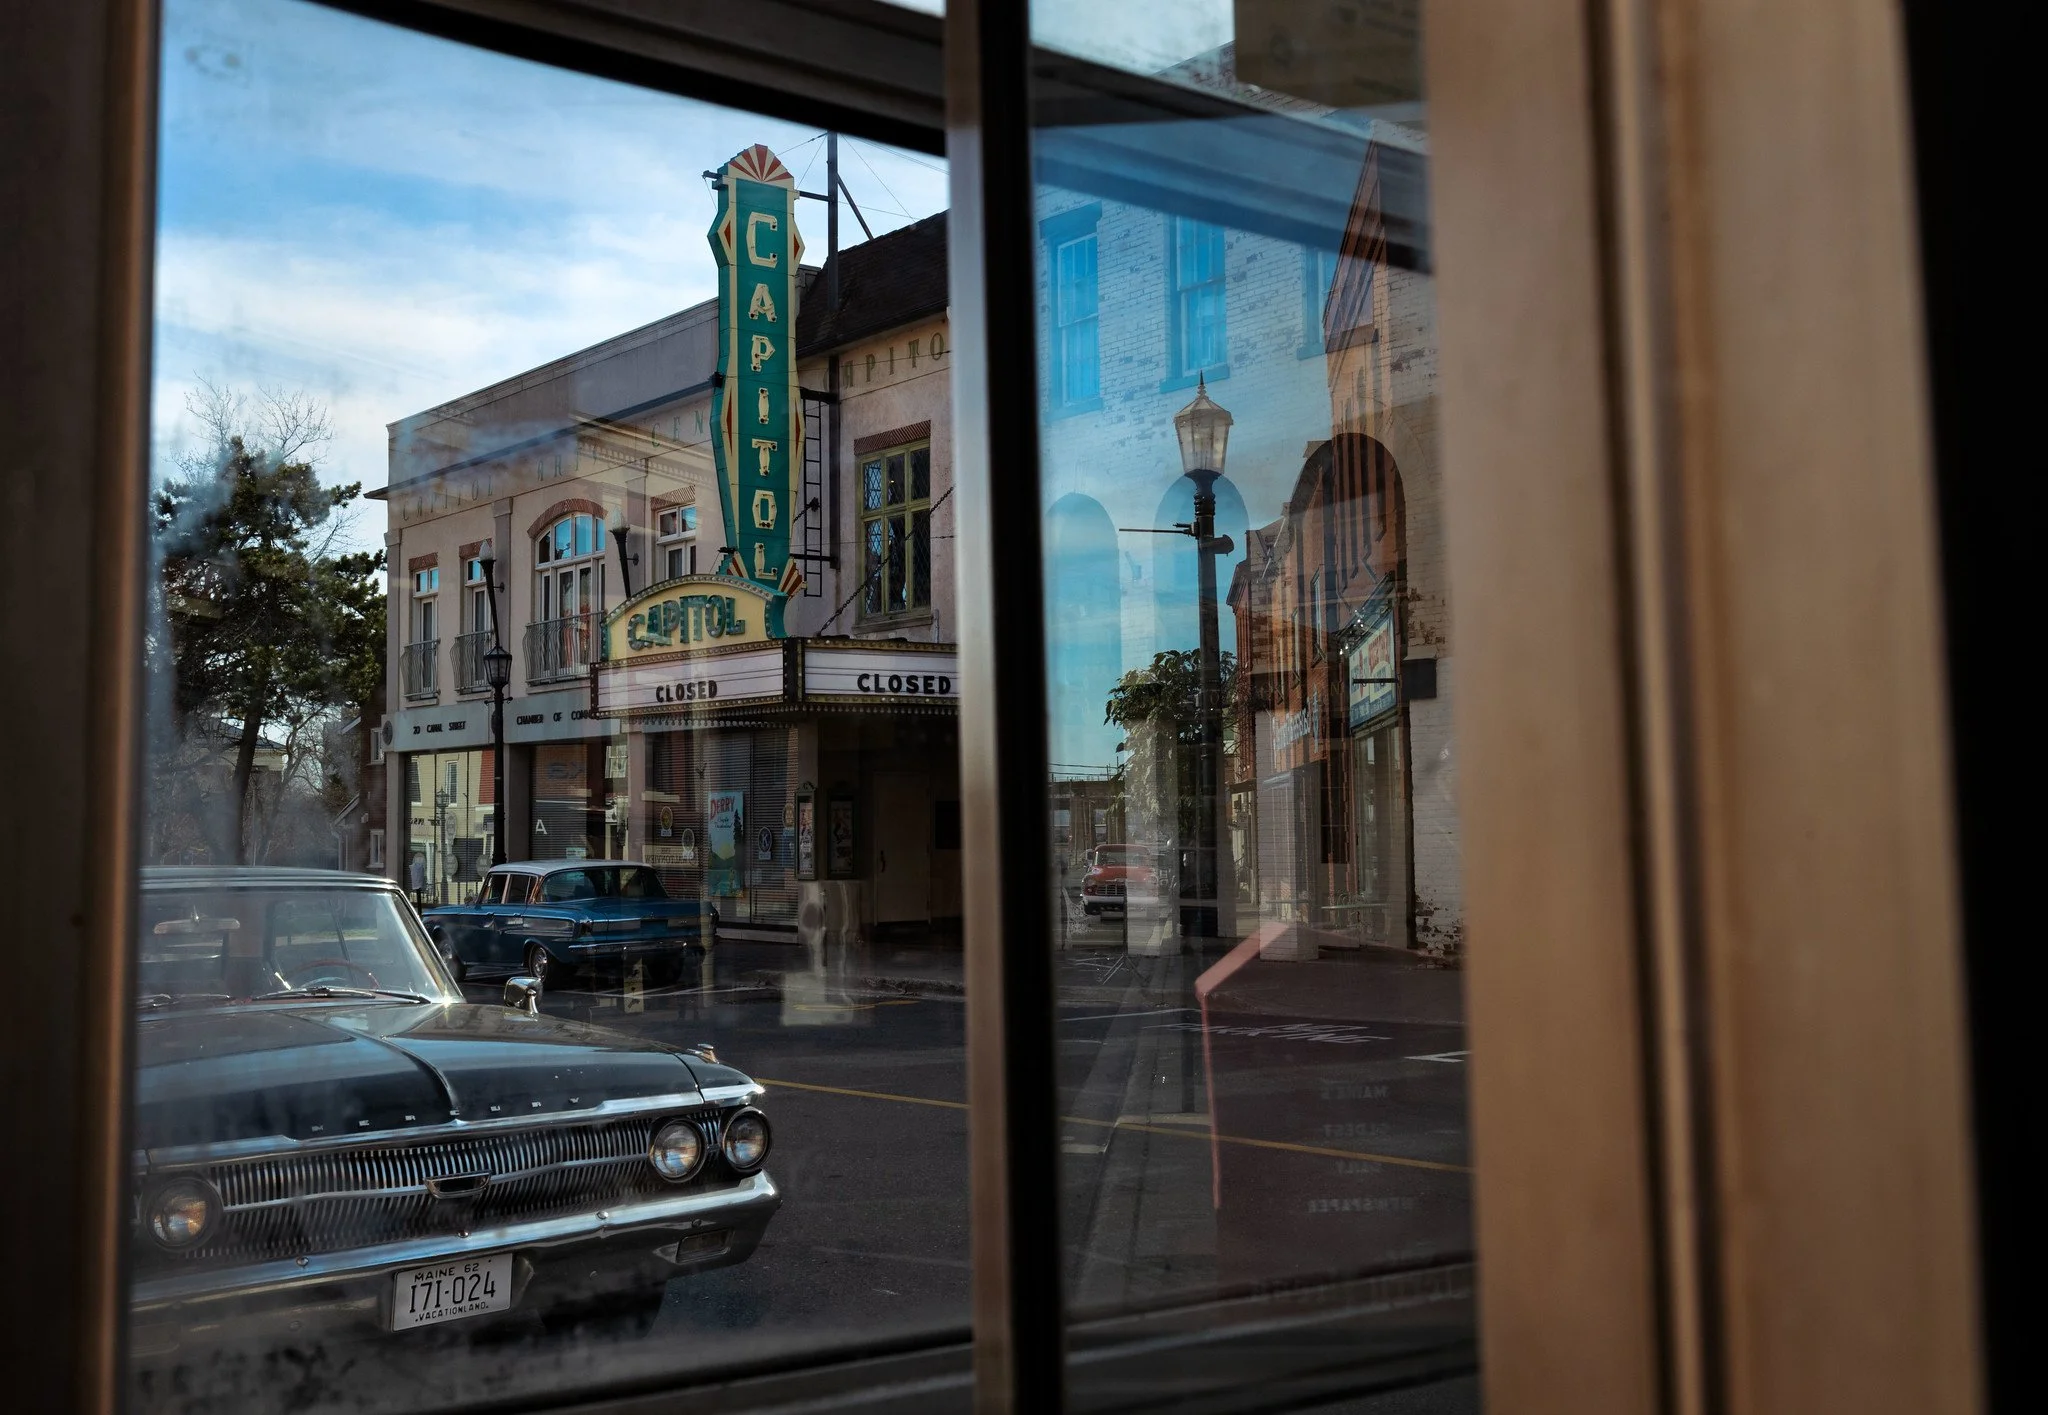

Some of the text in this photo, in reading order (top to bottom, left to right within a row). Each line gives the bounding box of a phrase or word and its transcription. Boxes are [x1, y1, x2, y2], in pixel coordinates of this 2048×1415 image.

[746, 211, 778, 580] CAPITOL
[628, 594, 745, 651] CAPITOL
[656, 680, 717, 702] CLOSED
[857, 673, 951, 695] CLOSED
[448, 720, 466, 731] STREET
[516, 714, 544, 725] CHAMBER
[553, 711, 563, 721] OF
[710, 796, 736, 821] DERRY
[535, 819, 547, 835] A
[414, 1263, 479, 1282] MAINE 62
[410, 1271, 495, 1314] 171-024
